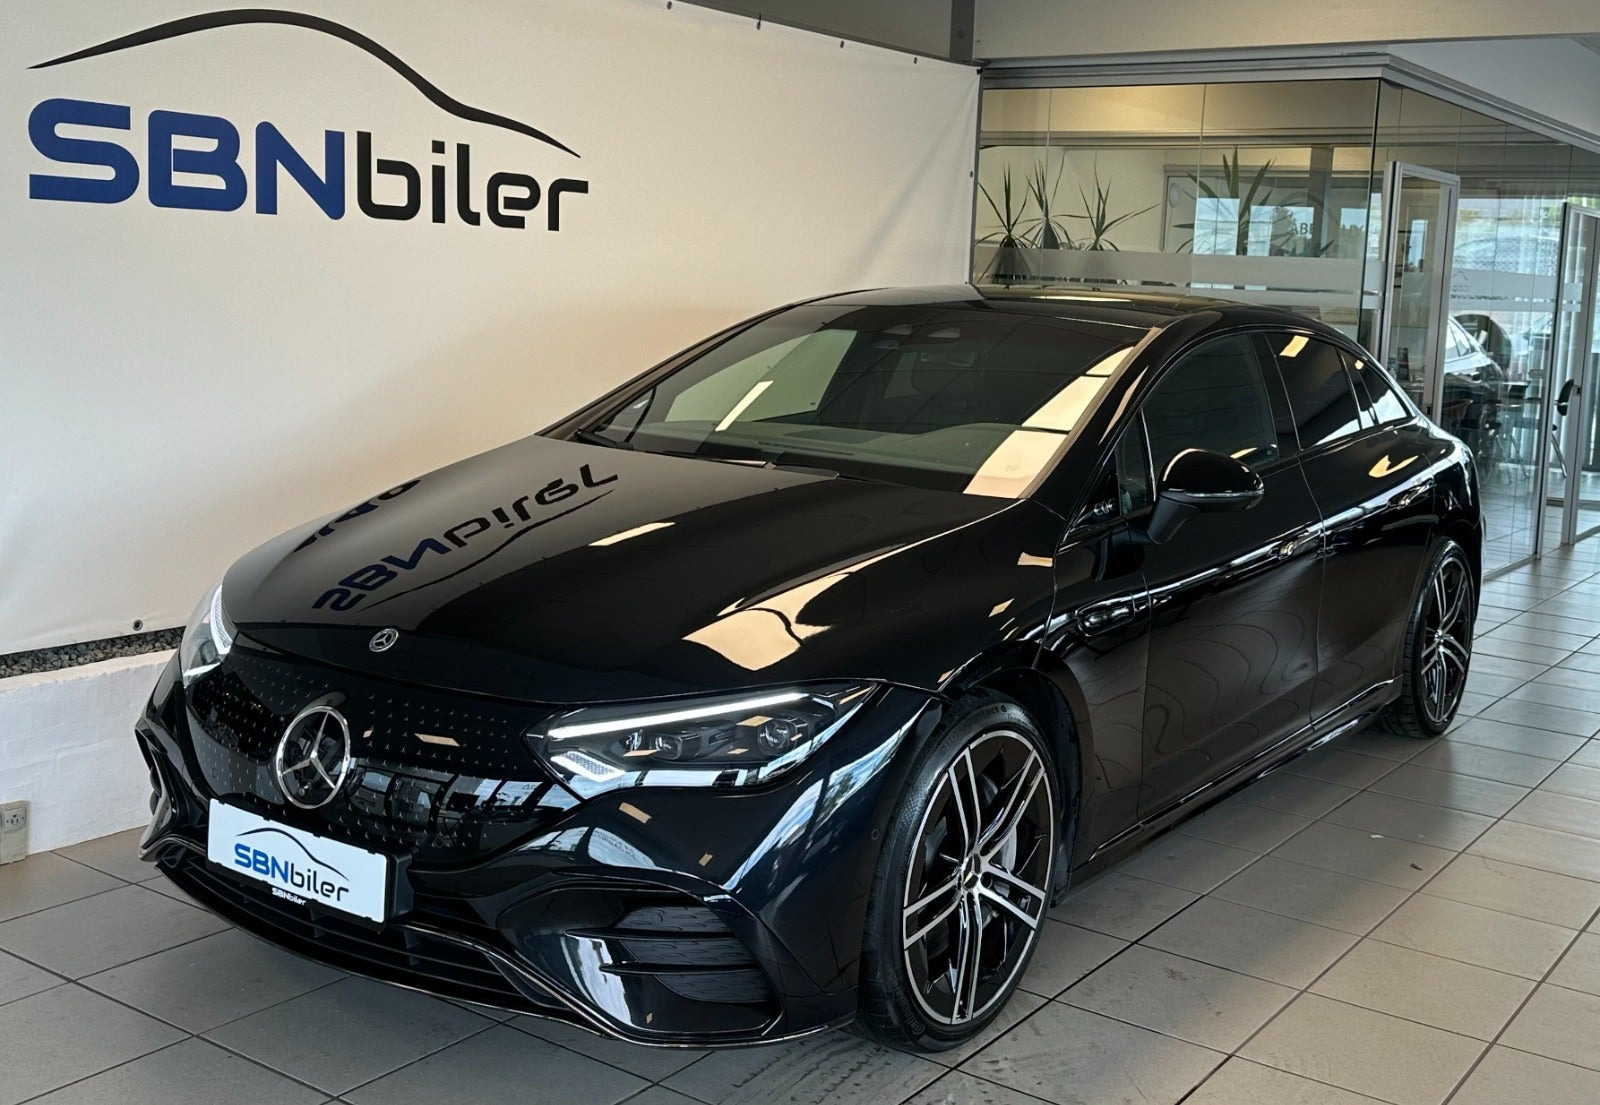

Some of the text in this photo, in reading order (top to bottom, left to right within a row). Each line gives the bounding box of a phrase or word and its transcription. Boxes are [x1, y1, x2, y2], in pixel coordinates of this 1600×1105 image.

[28, 97, 589, 232] SBNbiler
[235, 843, 349, 901] SBNbiler
[271, 887, 307, 906] SBNbiler
